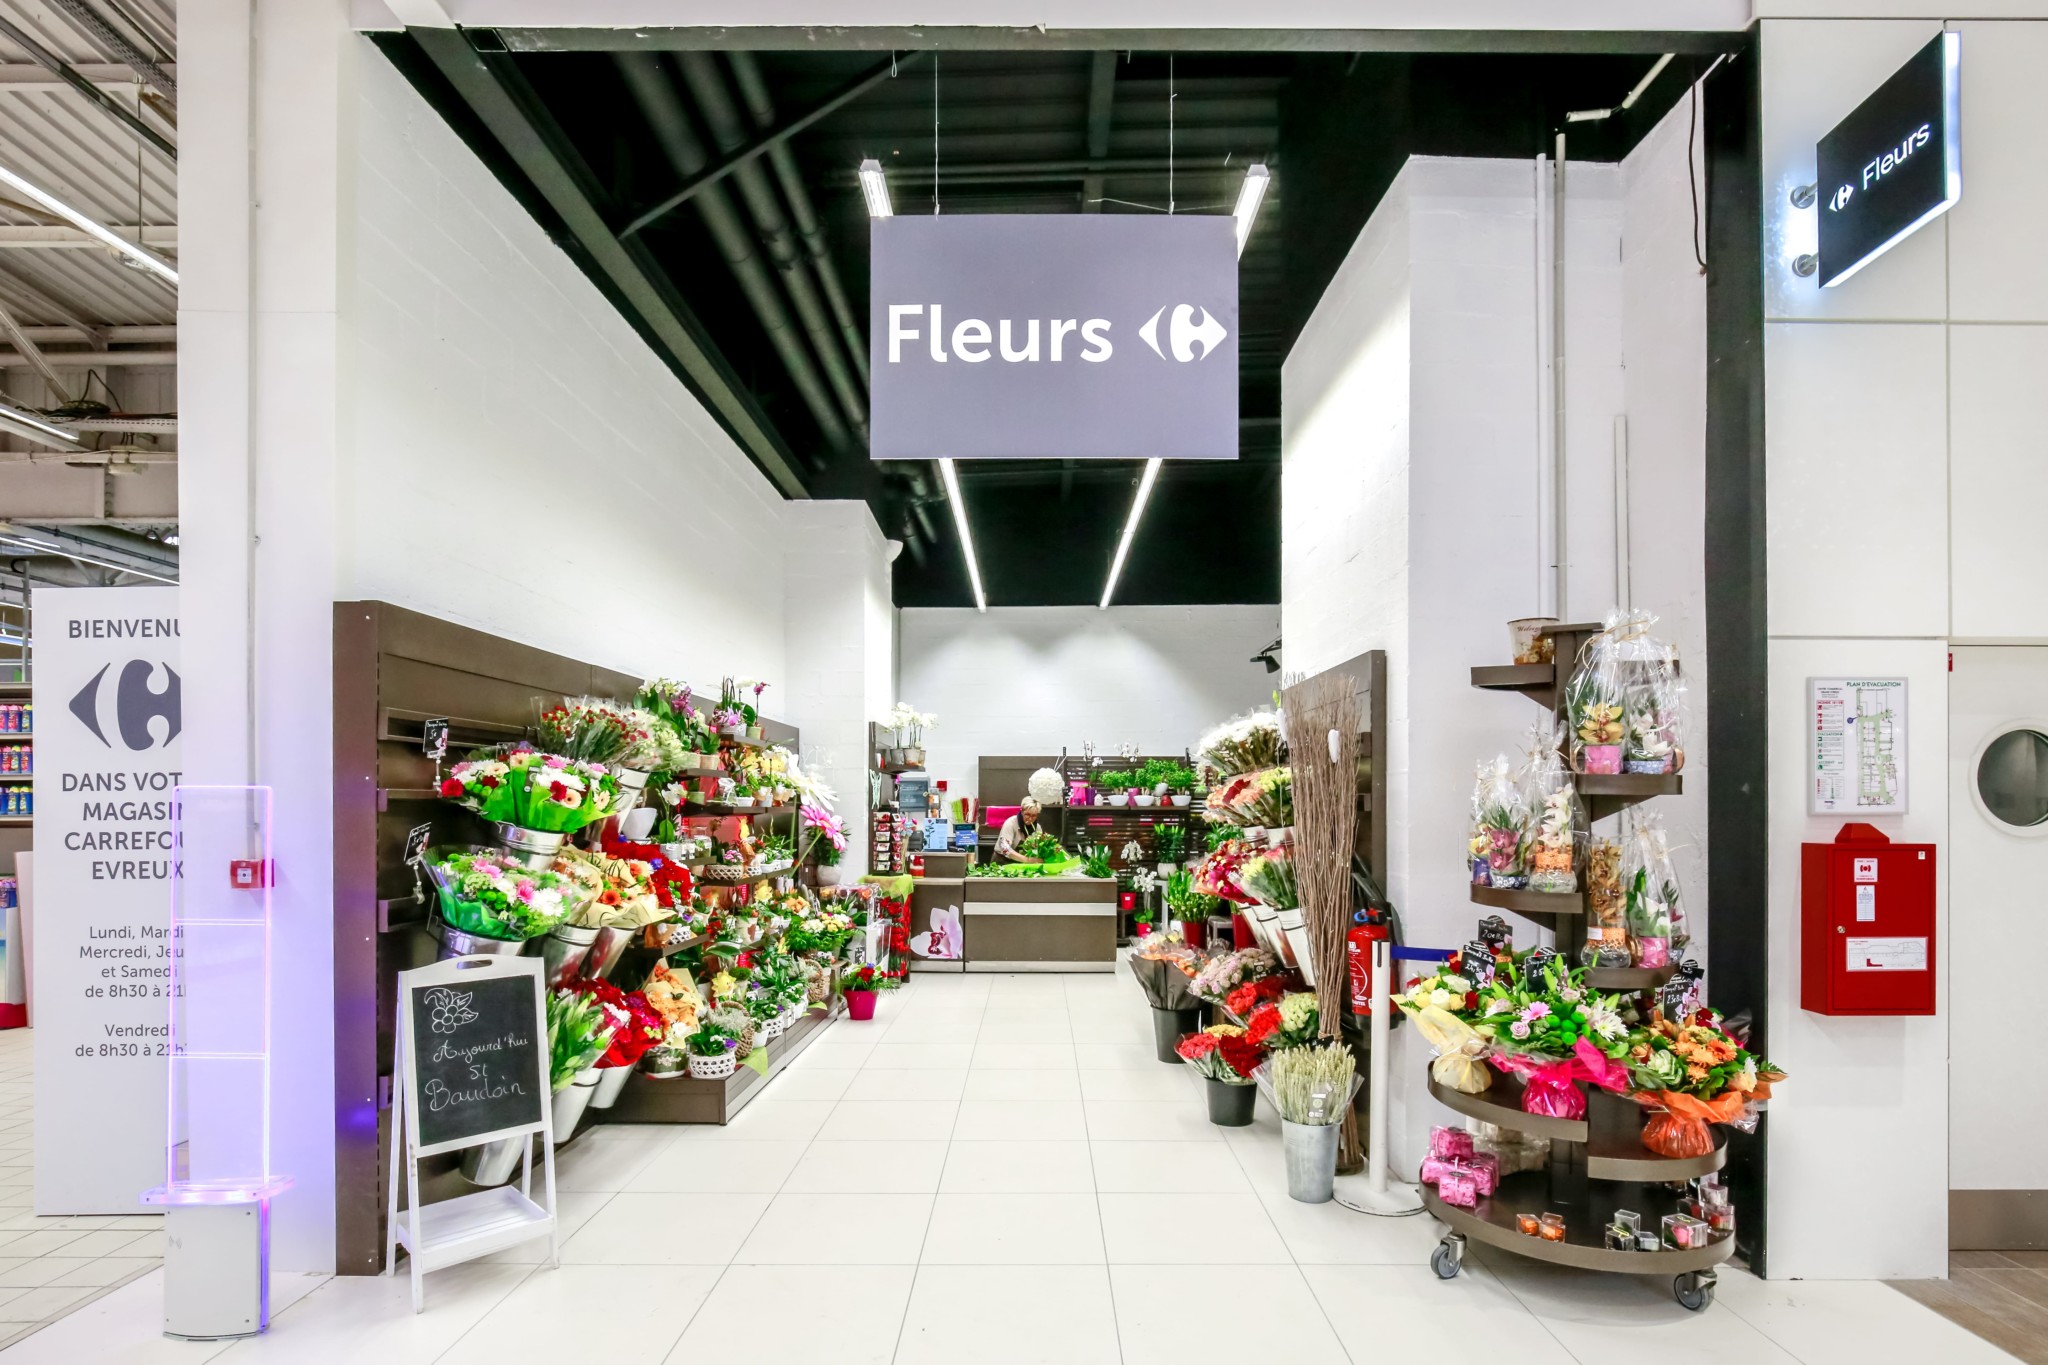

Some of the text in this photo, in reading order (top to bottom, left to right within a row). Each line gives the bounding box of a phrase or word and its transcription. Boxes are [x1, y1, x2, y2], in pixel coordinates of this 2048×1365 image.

[1862, 123, 1931, 191] Fleurs
[888, 303, 1113, 363] Fleurs
[62, 772, 126, 792] DANS
[64, 830, 183, 851] CARREFO
[92, 860, 184, 880] EVREUX
[90, 926, 135, 940] Lundi,
[80, 945, 151, 960] Mercredi,
[102, 964, 178, 978] et Samedi
[85, 984, 104, 998] de
[109, 984, 148, 998] 8h30
[153, 984, 160, 998] à
[105, 1024, 175, 1036] Vendredi
[75, 1044, 94, 1056] de
[99, 1044, 138, 1056] 8h30
[143, 1044, 151, 1056] à
[424, 1076, 526, 1112] Baudoin
